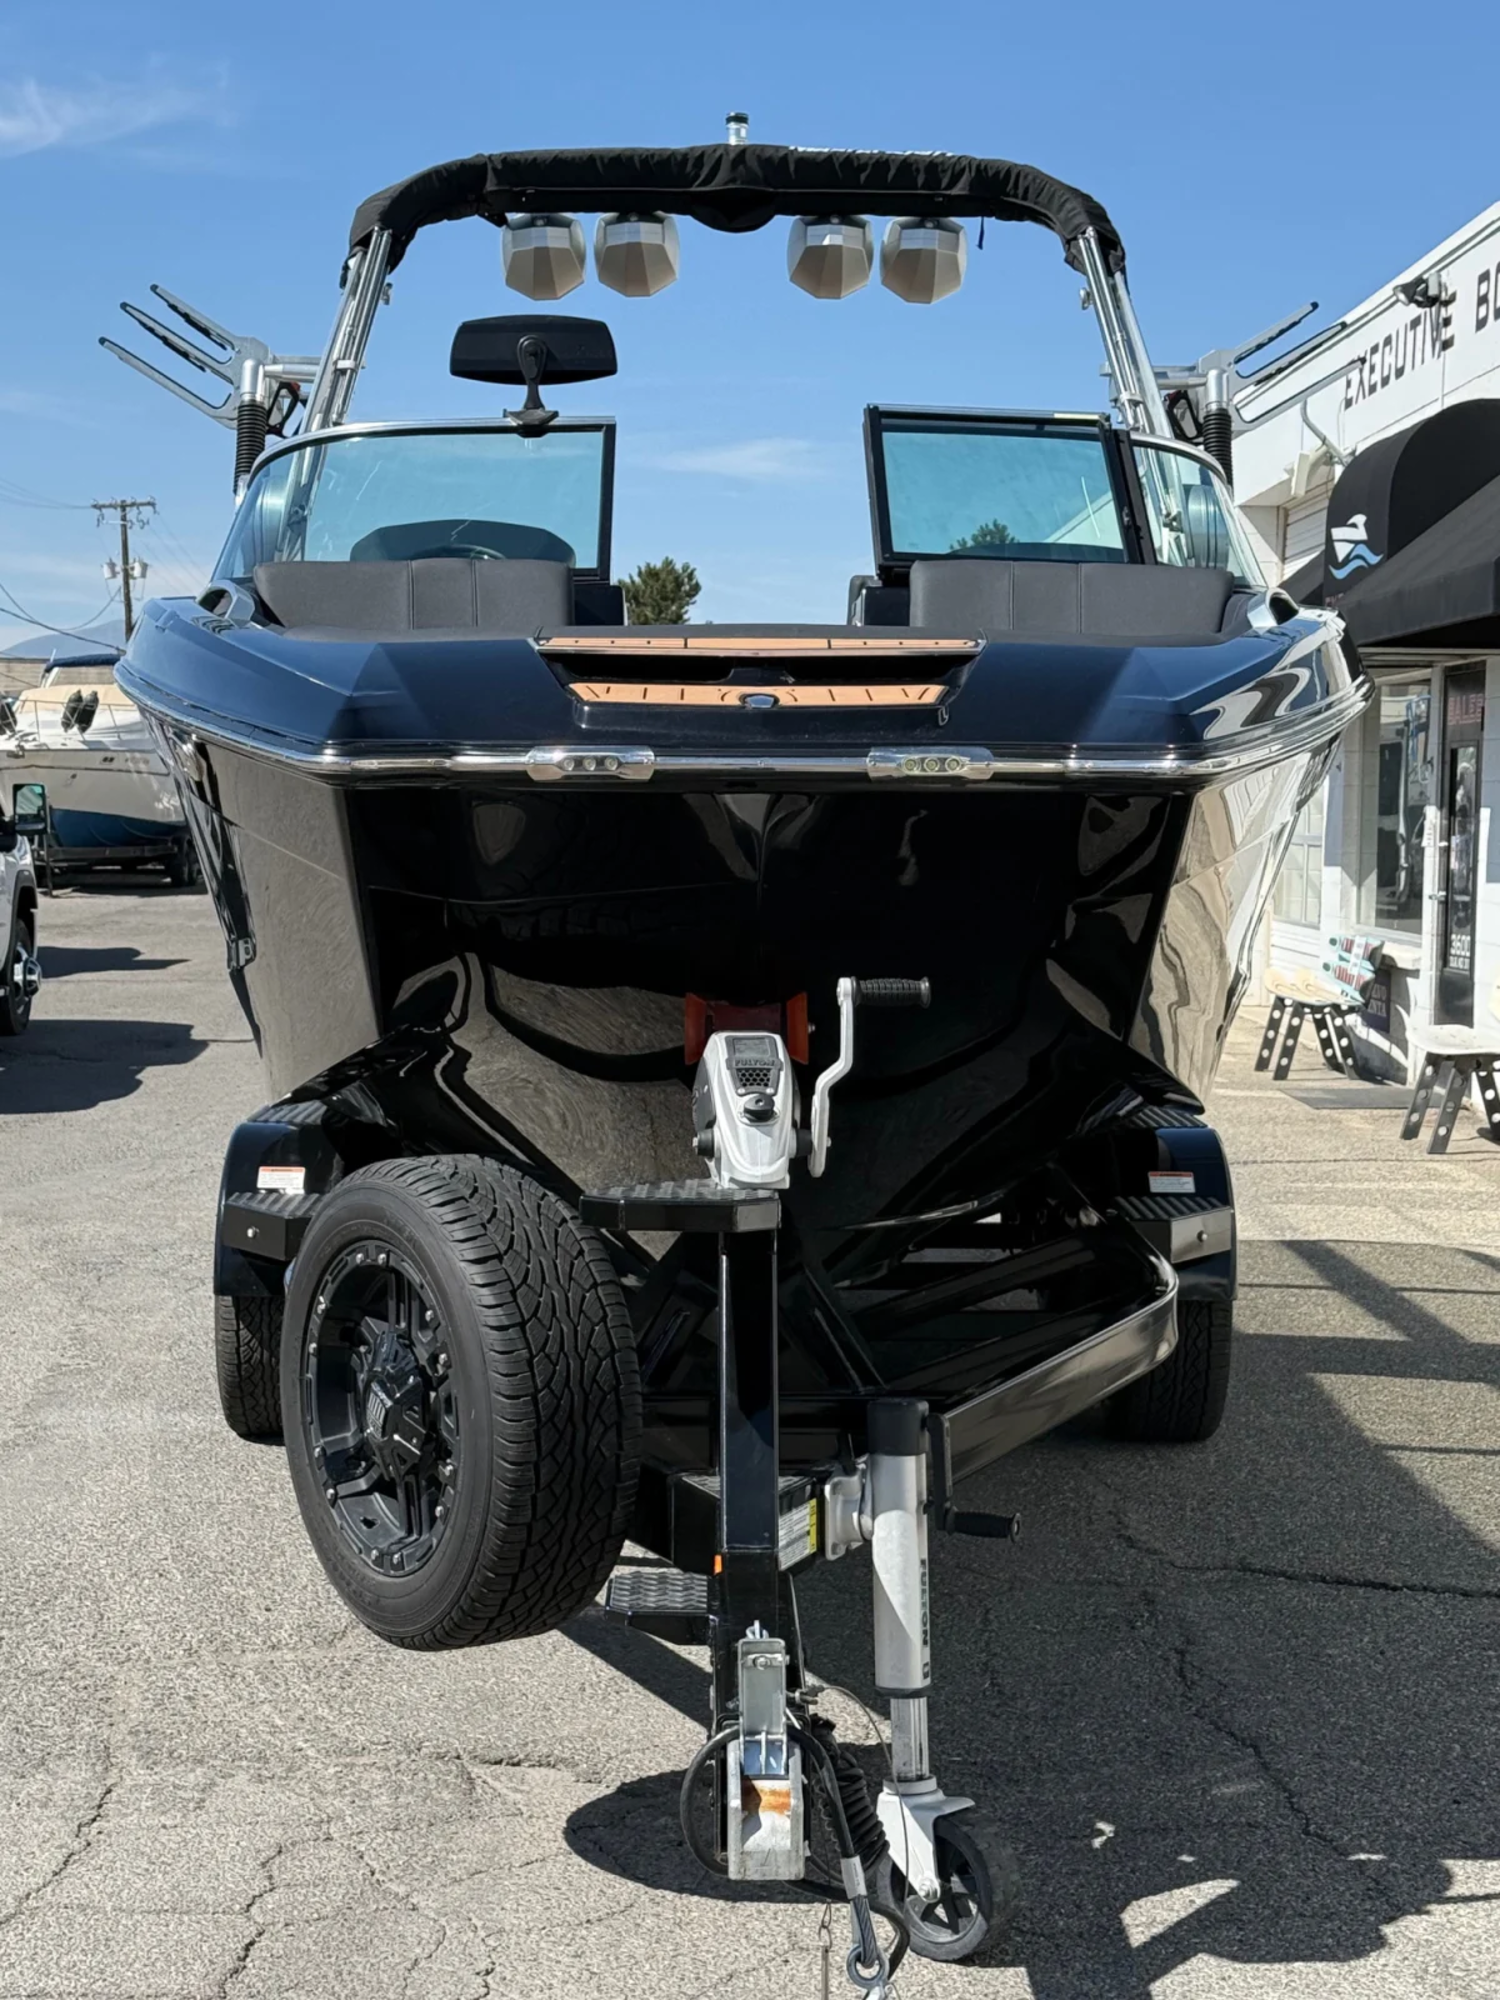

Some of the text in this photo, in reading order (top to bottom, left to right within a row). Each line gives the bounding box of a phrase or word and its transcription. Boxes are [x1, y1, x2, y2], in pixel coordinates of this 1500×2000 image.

[1344, 289, 1457, 412] EXECUTIVE
[1450, 933, 1471, 957] 3600
[920, 1558, 929, 1647] FULTON
